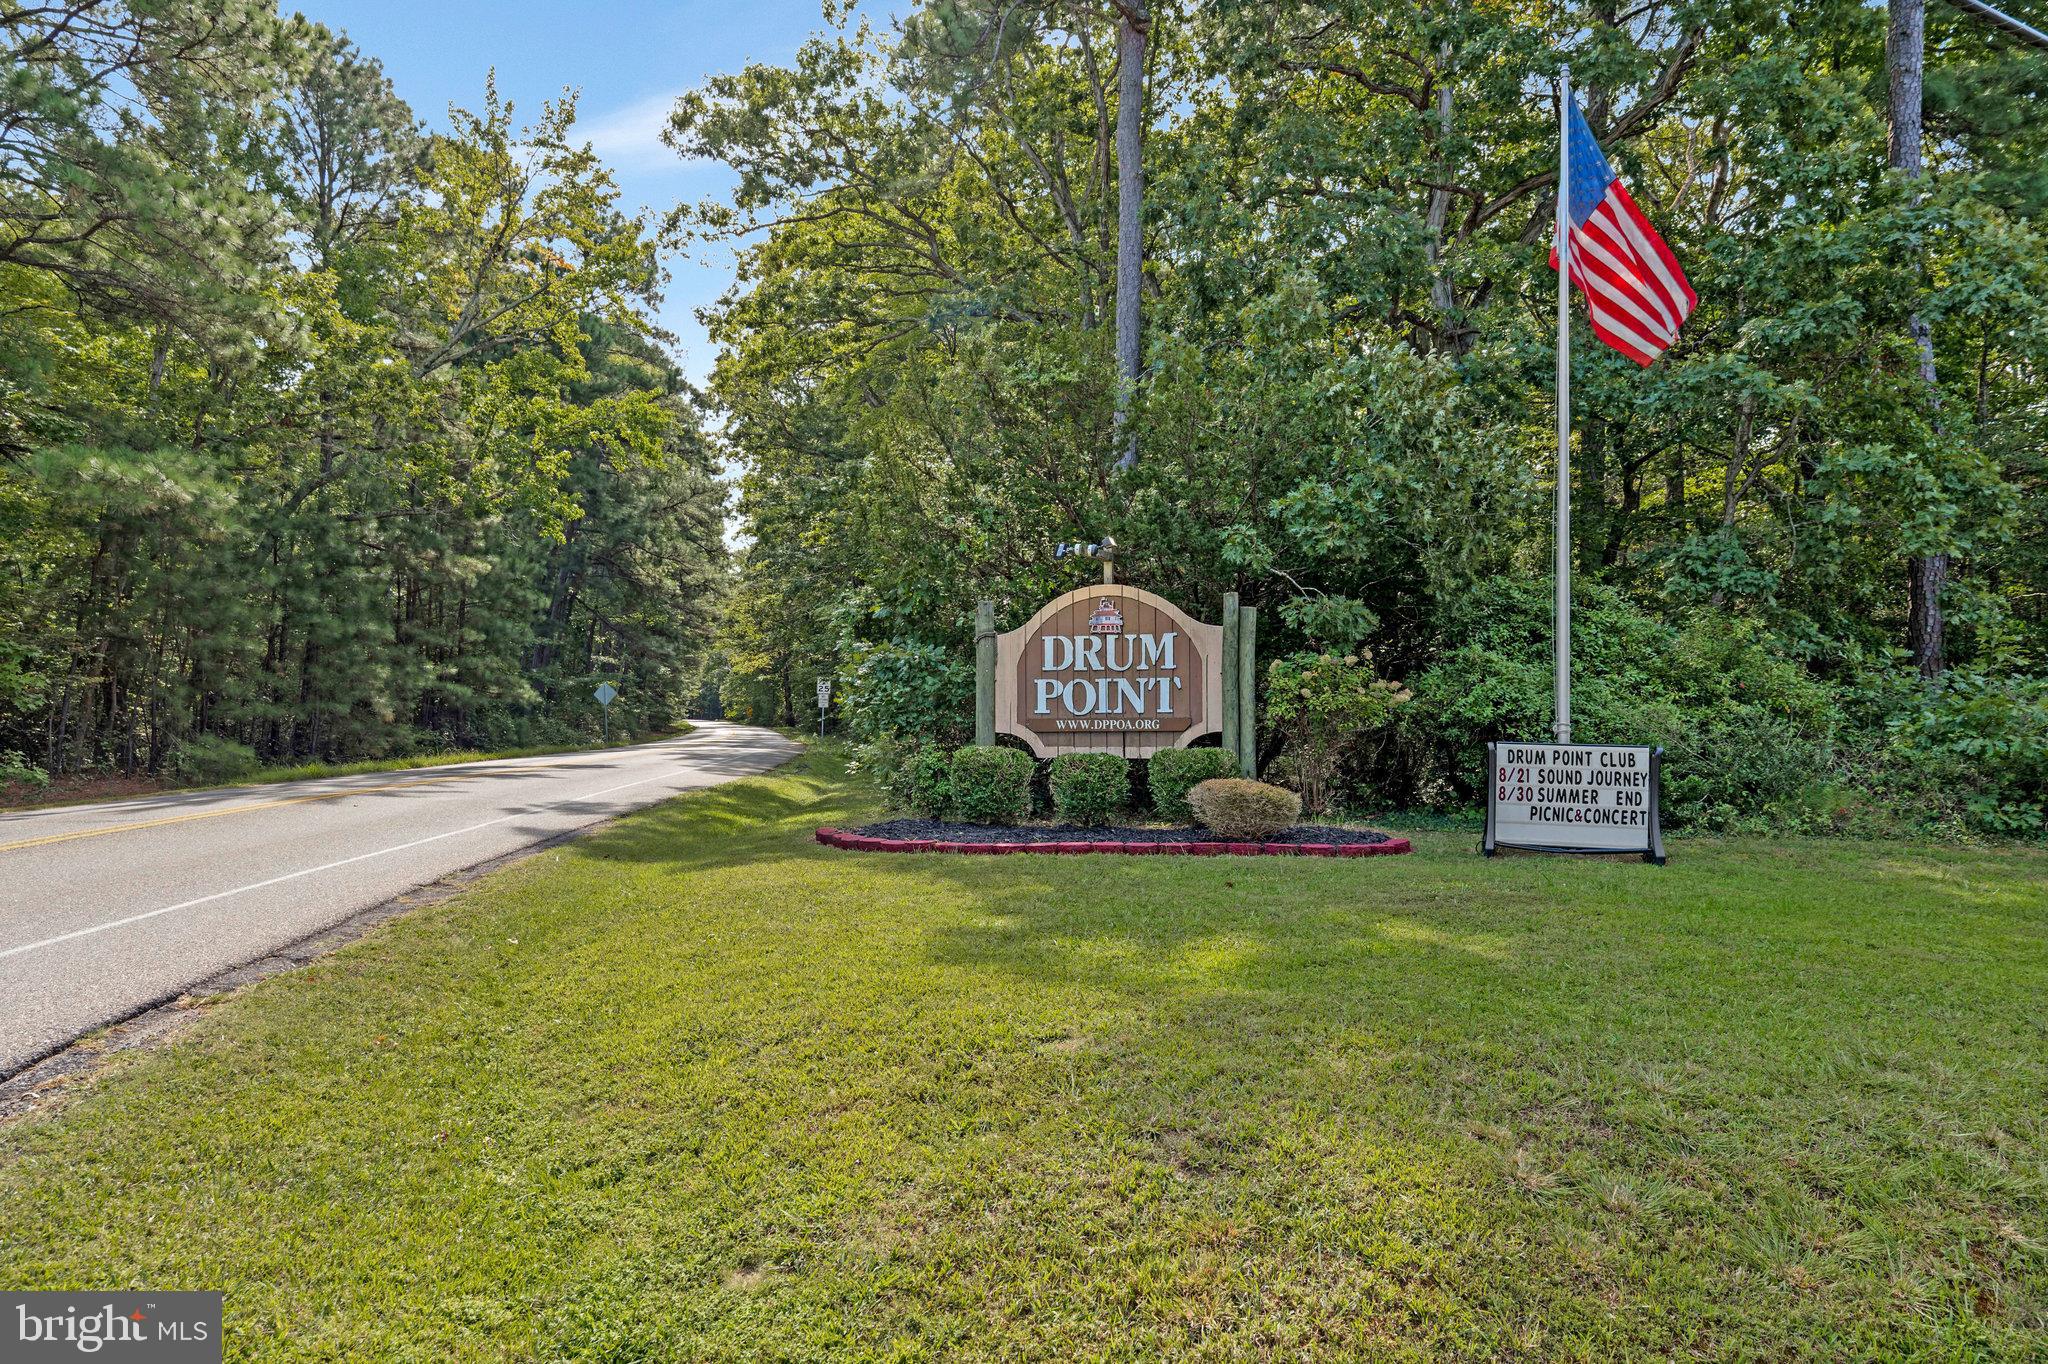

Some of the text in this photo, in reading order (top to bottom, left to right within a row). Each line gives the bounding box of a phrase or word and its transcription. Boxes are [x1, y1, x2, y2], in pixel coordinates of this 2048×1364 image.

[1042, 632, 1178, 671] DRUM
[1056, 719, 1160, 730] WWW.DPPOA.ORG
[1508, 749, 1636, 767] DRUM POINT CLUB
[1499, 767, 1648, 787] 8/21 SOUND JOURNEY
[1498, 785, 1642, 806] 8/30 SUMMER END
[1530, 806, 1647, 825] PICNIC&CONCERT
